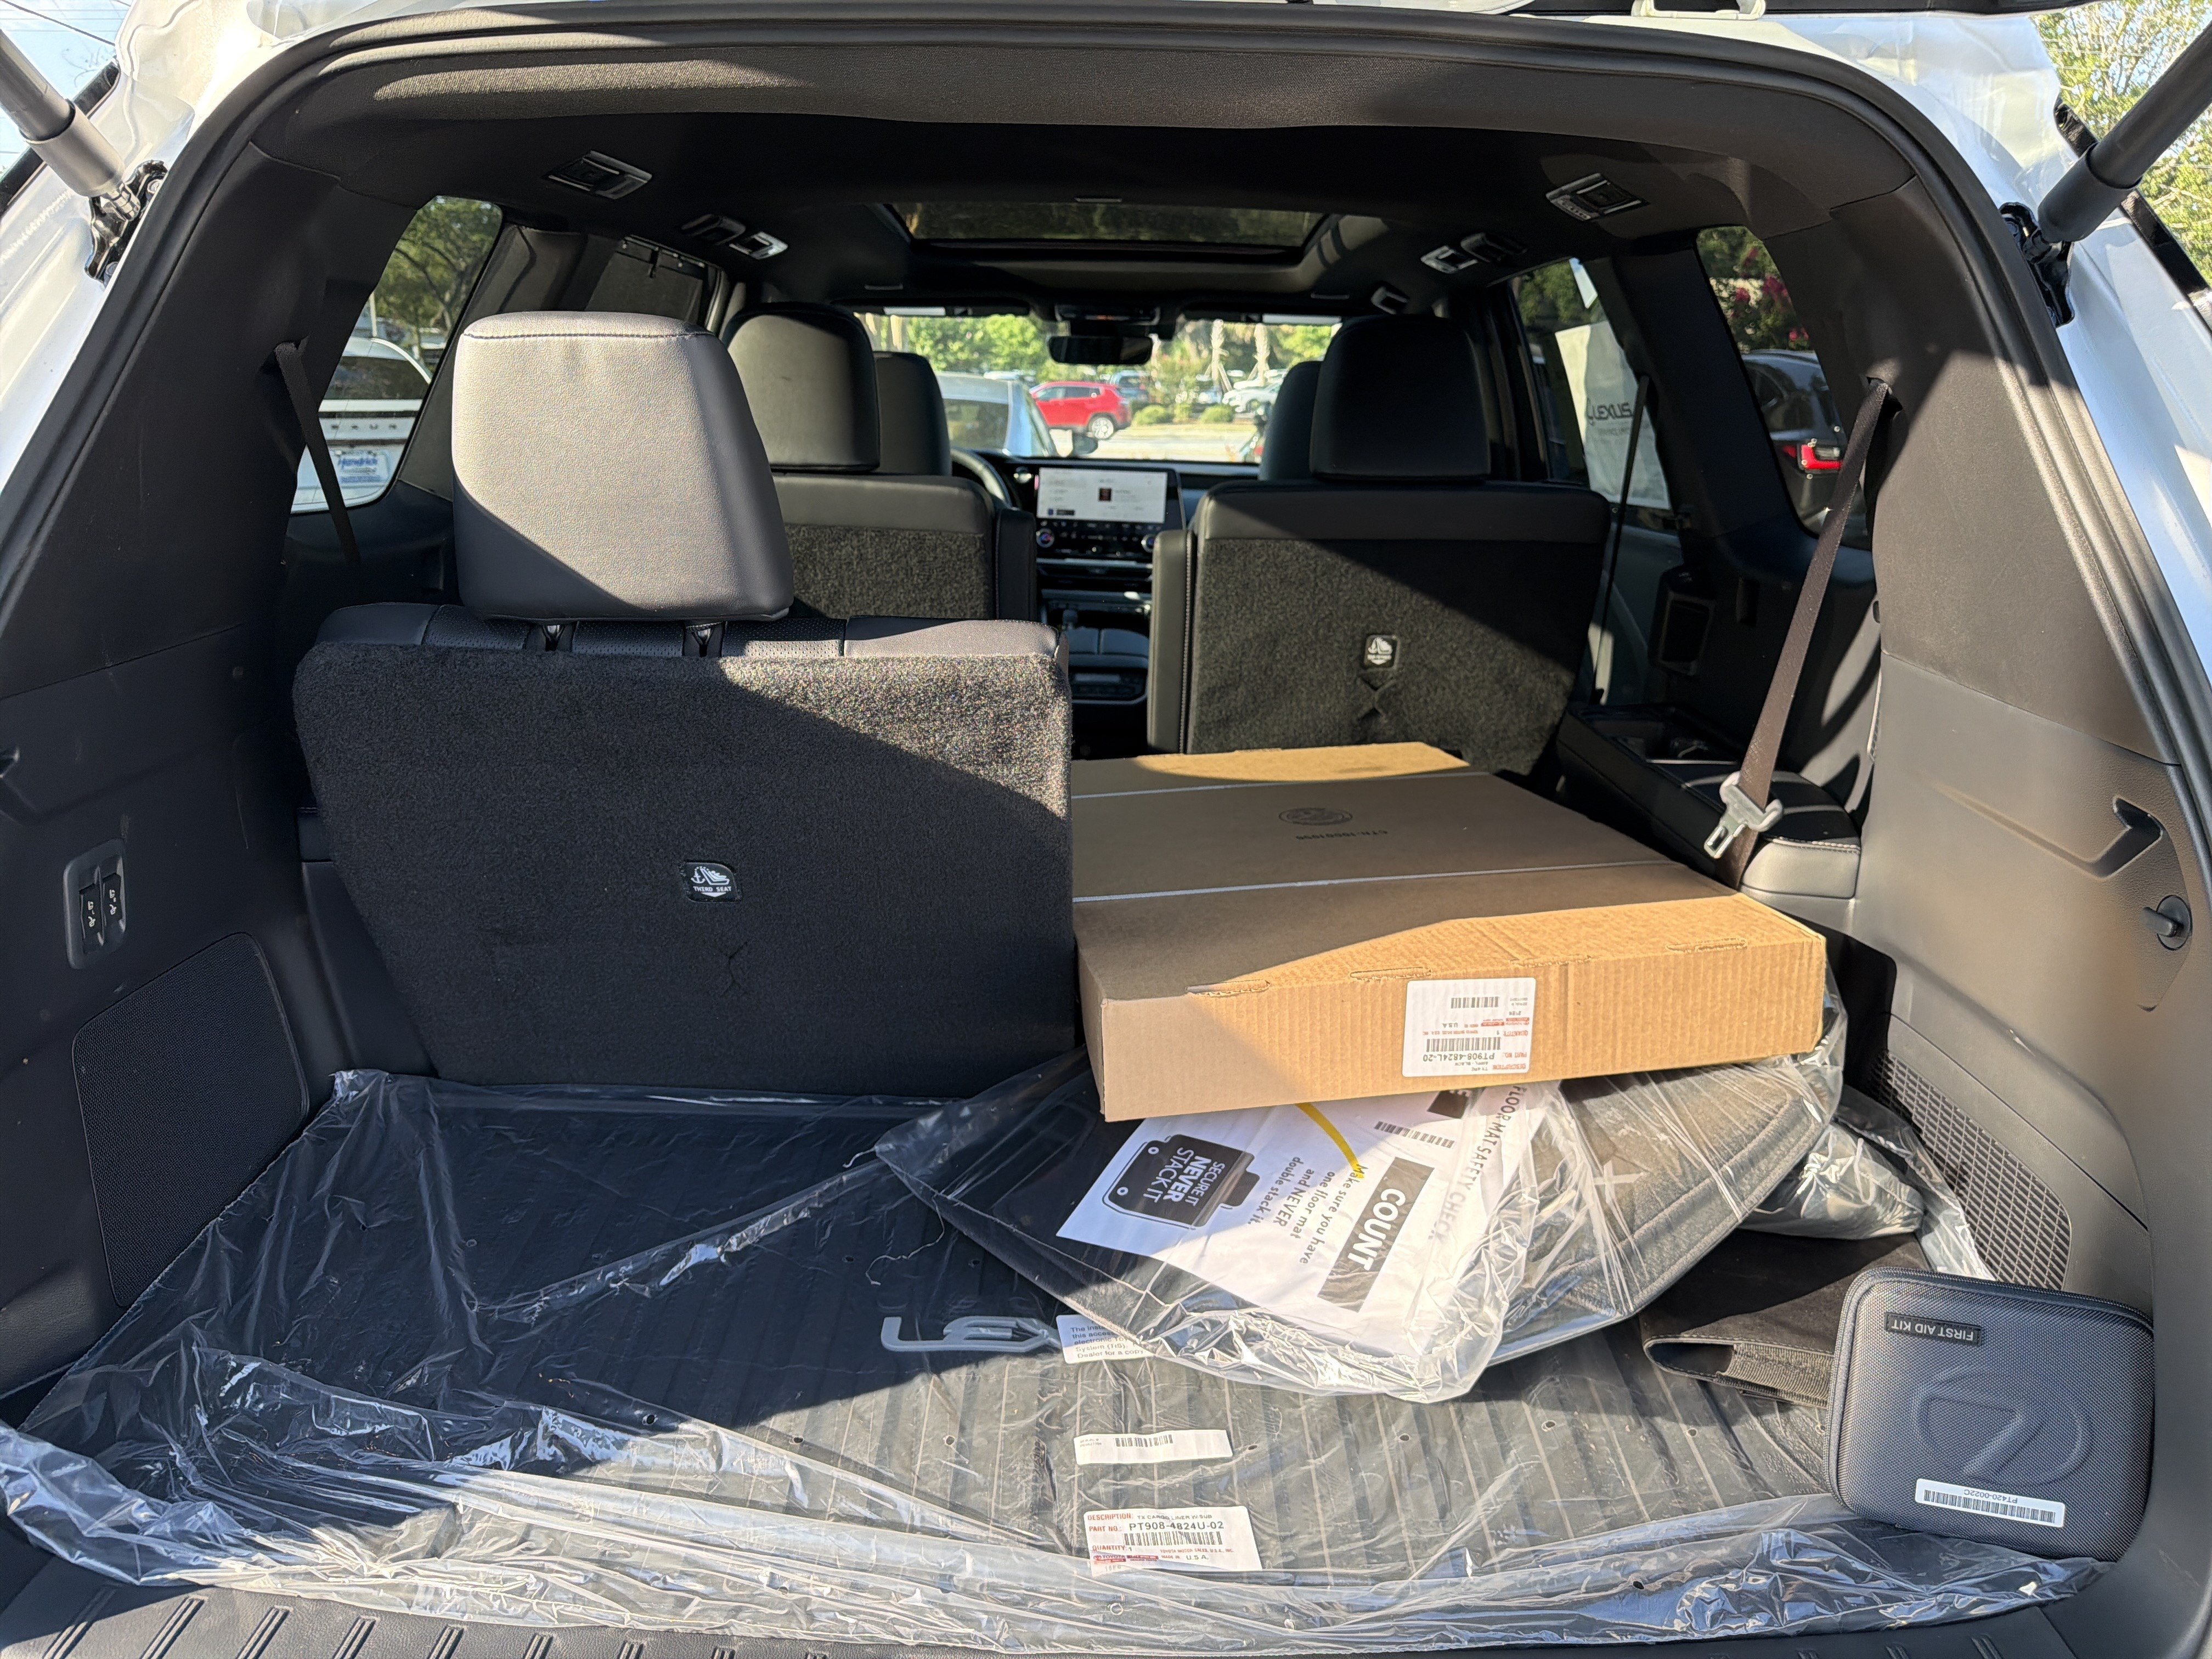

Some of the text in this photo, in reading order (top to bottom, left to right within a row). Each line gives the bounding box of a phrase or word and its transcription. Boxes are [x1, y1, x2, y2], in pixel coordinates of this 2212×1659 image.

[1423, 1053, 1495, 1062] PT908-4824L-20
[1496, 1086, 1527, 1125] FLOOR
[1484, 1122, 1506, 1146] MAT
[1143, 1147, 1194, 1203] STACK IT
[1163, 1155, 1212, 1202] NEVER
[1185, 1161, 1226, 1206] SECURE IT
[1248, 1156, 1304, 1224] double stack it.
[1458, 1146, 1492, 1190] SAFETY
[1273, 1169, 1314, 1227] and NEVER
[1290, 1171, 1335, 1239] one floor mat
[1300, 1164, 1368, 1263] Make sure you have
[1347, 1188, 1406, 1271] COUNT
[1074, 1337, 1111, 1345] electronic
[1891, 1319, 1974, 1341] FIRST AID KIT
[1963, 1489, 2018, 1504] PT420-0022C
[1128, 1521, 1224, 1531] PT908-4824U-02
